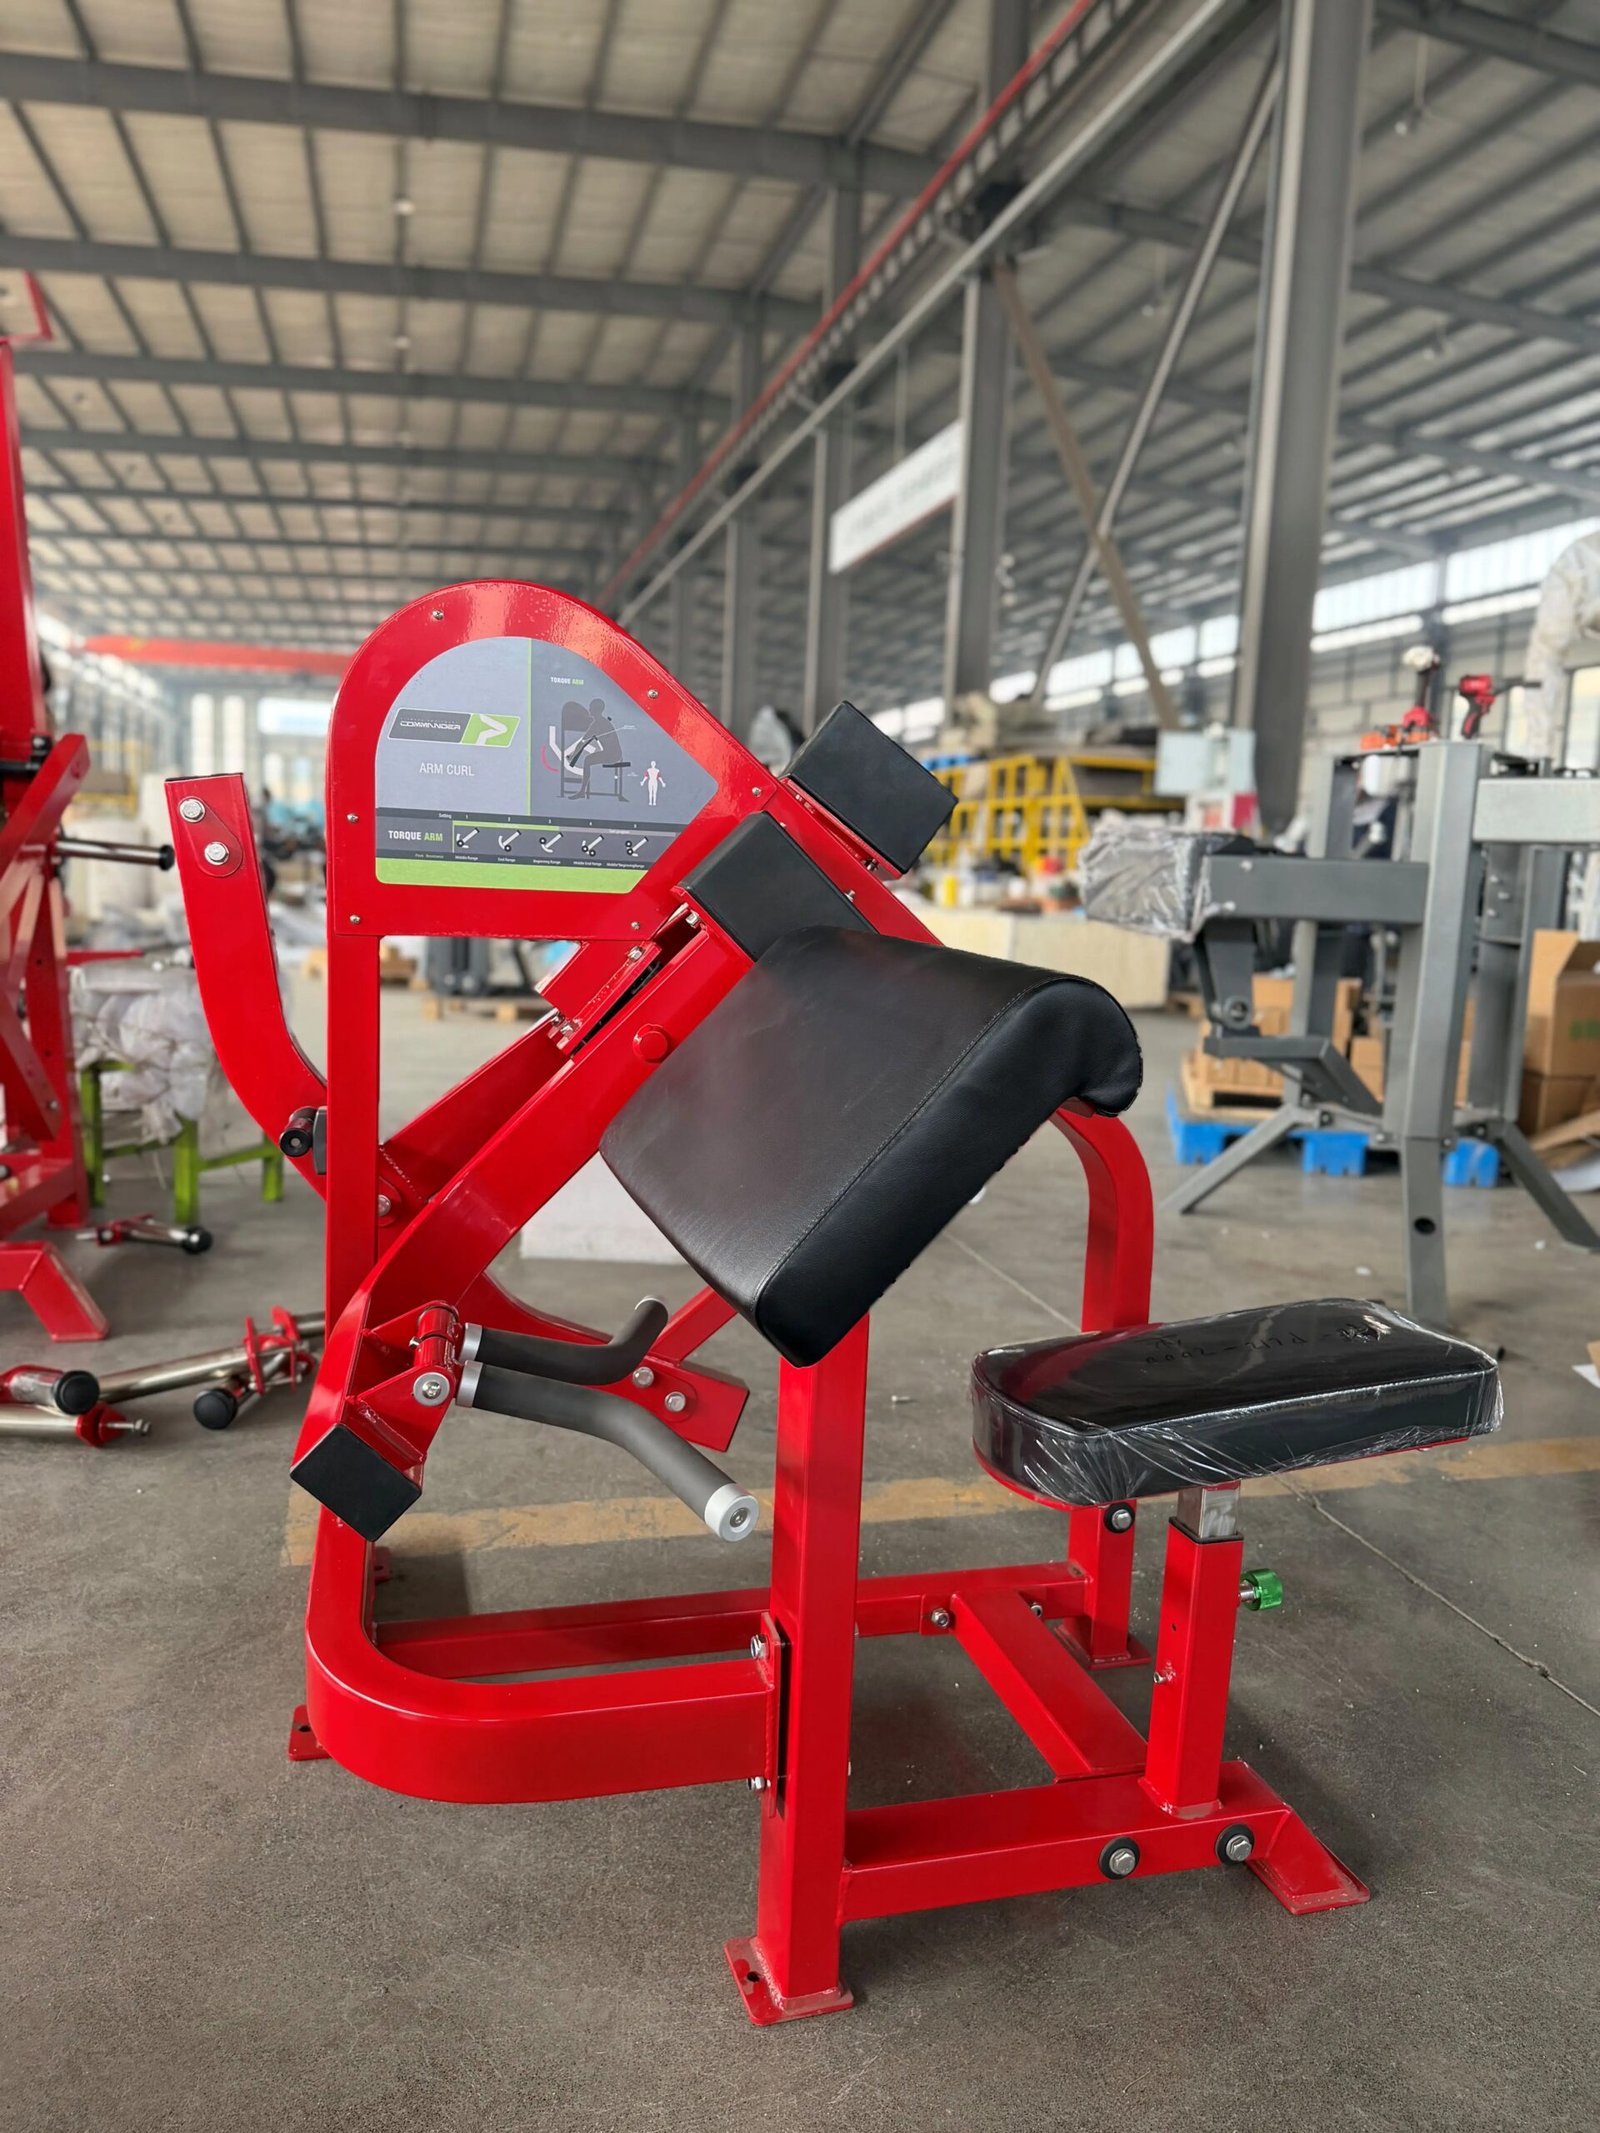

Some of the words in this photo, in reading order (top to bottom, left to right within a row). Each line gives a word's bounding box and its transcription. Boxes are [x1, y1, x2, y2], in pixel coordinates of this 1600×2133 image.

[550, 676, 571, 685] TORQUE
[571, 678, 585, 686] ARM
[399, 720, 462, 732] COMMANDER
[419, 762, 444, 775] ARM
[446, 763, 475, 777] CURL
[388, 830, 422, 841] TORQUE
[423, 832, 443, 842] ARM
